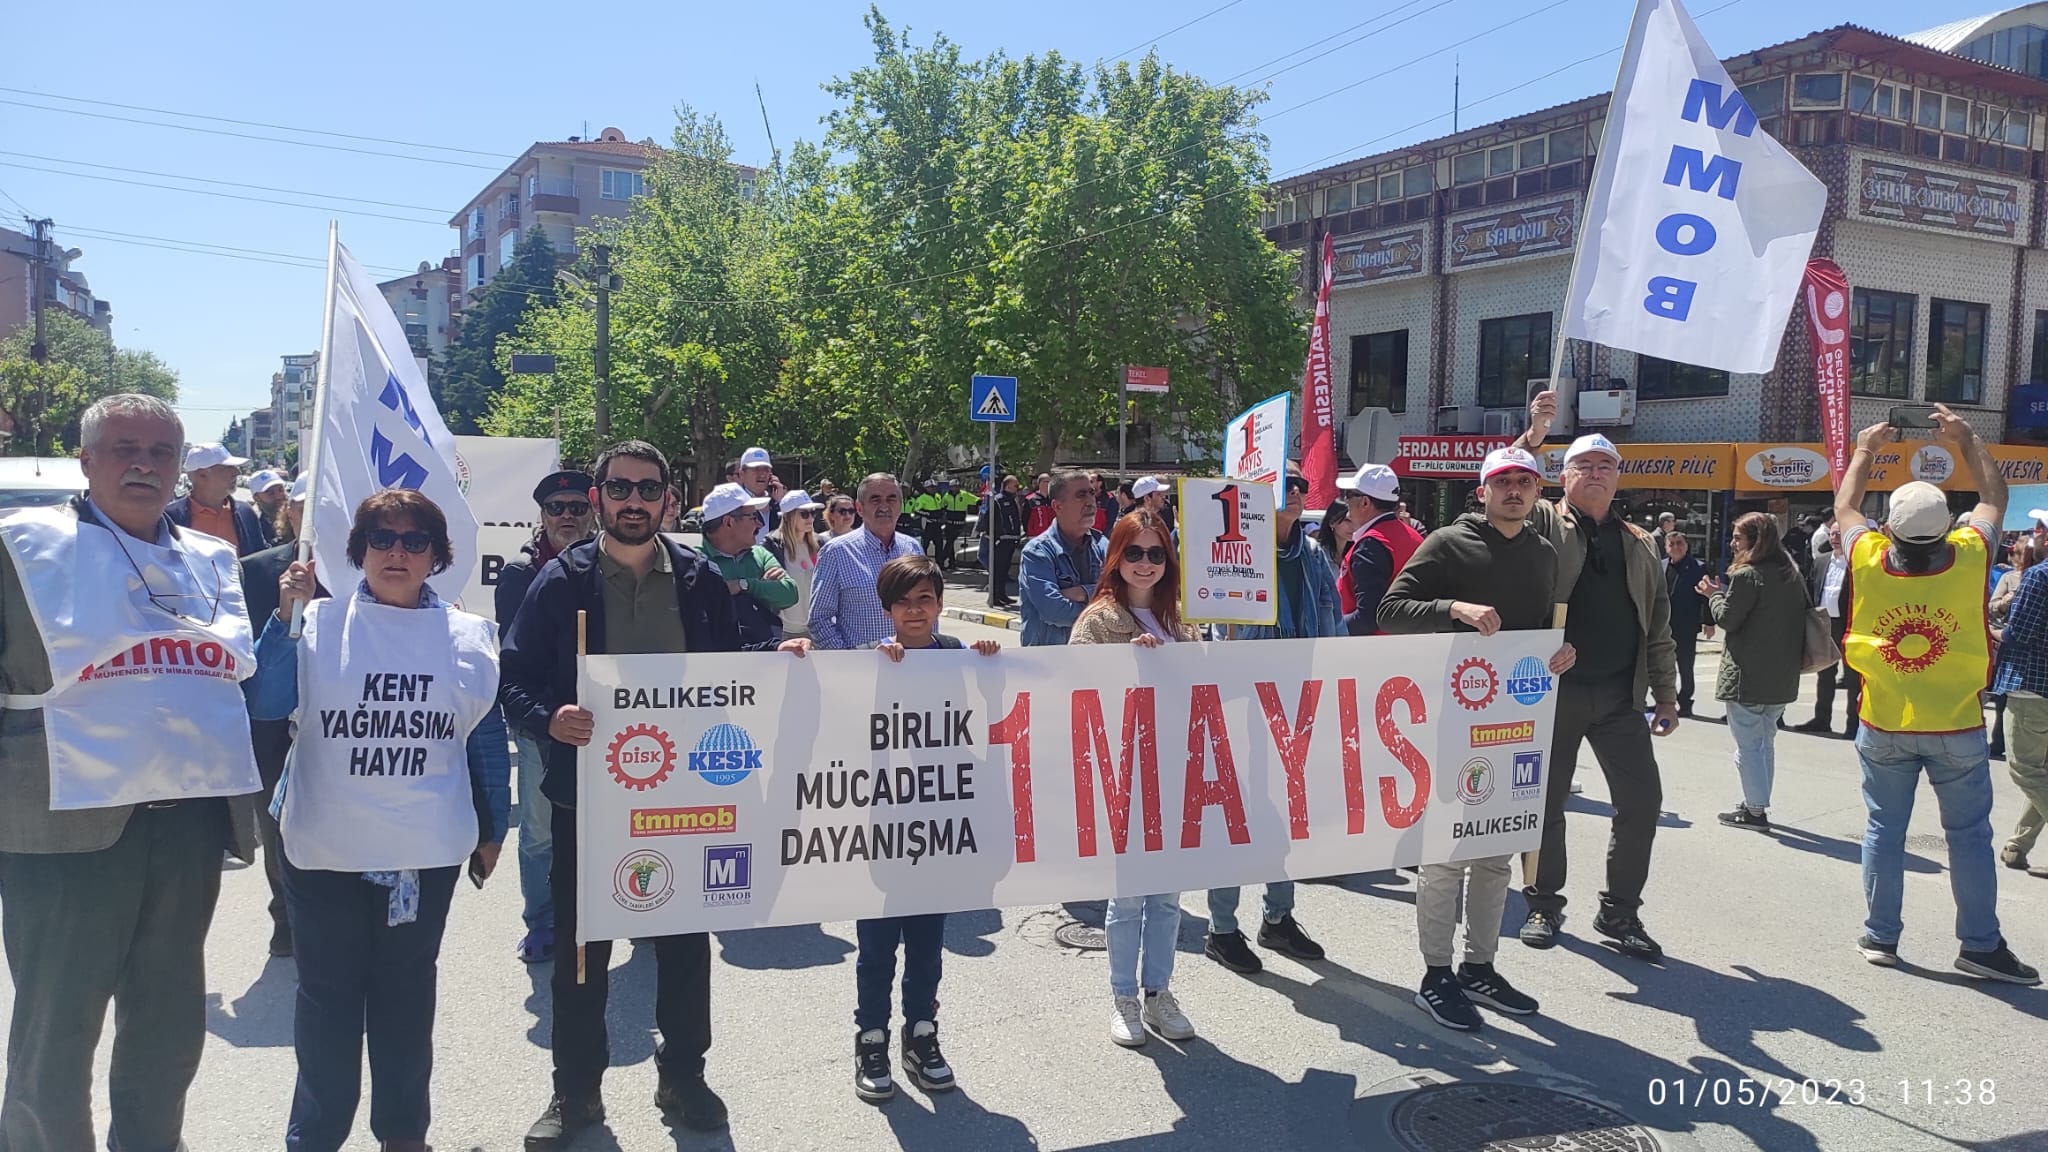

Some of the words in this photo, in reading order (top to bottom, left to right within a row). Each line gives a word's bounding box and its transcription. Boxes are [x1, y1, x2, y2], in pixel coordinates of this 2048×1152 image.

[2028, 401, 2048, 414] ŞE
[1240, 412, 1259, 460] 1
[1238, 450, 1262, 476] MAYIS
[1680, 455, 1717, 478] PİLİÇ
[1872, 452, 1900, 464] ESİR
[1995, 456, 2043, 480] IKESİR
[1211, 484, 1247, 543] 1
[1211, 541, 1252, 566] MAYIS
[1872, 602, 1928, 637] EĞİTİM
[1934, 607, 1960, 633] SEN
[94, 667, 150, 680] MÜHENDİS
[166, 667, 193, 675] MİMAR
[1462, 675, 1489, 689] DİSK
[1506, 676, 1553, 694] KESK
[362, 673, 434, 702] KENT
[614, 680, 756, 709] BALIKESİR
[320, 703, 456, 740] YAĞMASINA
[870, 700, 974, 751] BİRLİK
[1471, 723, 1533, 742] tmmob
[350, 747, 428, 776] HAYIR
[622, 746, 662, 764] DİSK
[688, 750, 763, 771] KESK
[715, 774, 736, 783] 1995
[988, 692, 1036, 863] 1
[1072, 676, 1431, 857] MAYIS
[796, 760, 975, 811] MÜCADELE
[633, 807, 734, 830] tmmob
[1453, 810, 1538, 840] BALIKESİR
[781, 817, 978, 866] DAYANIŞMA
[703, 891, 751, 902] TÜRMOB
